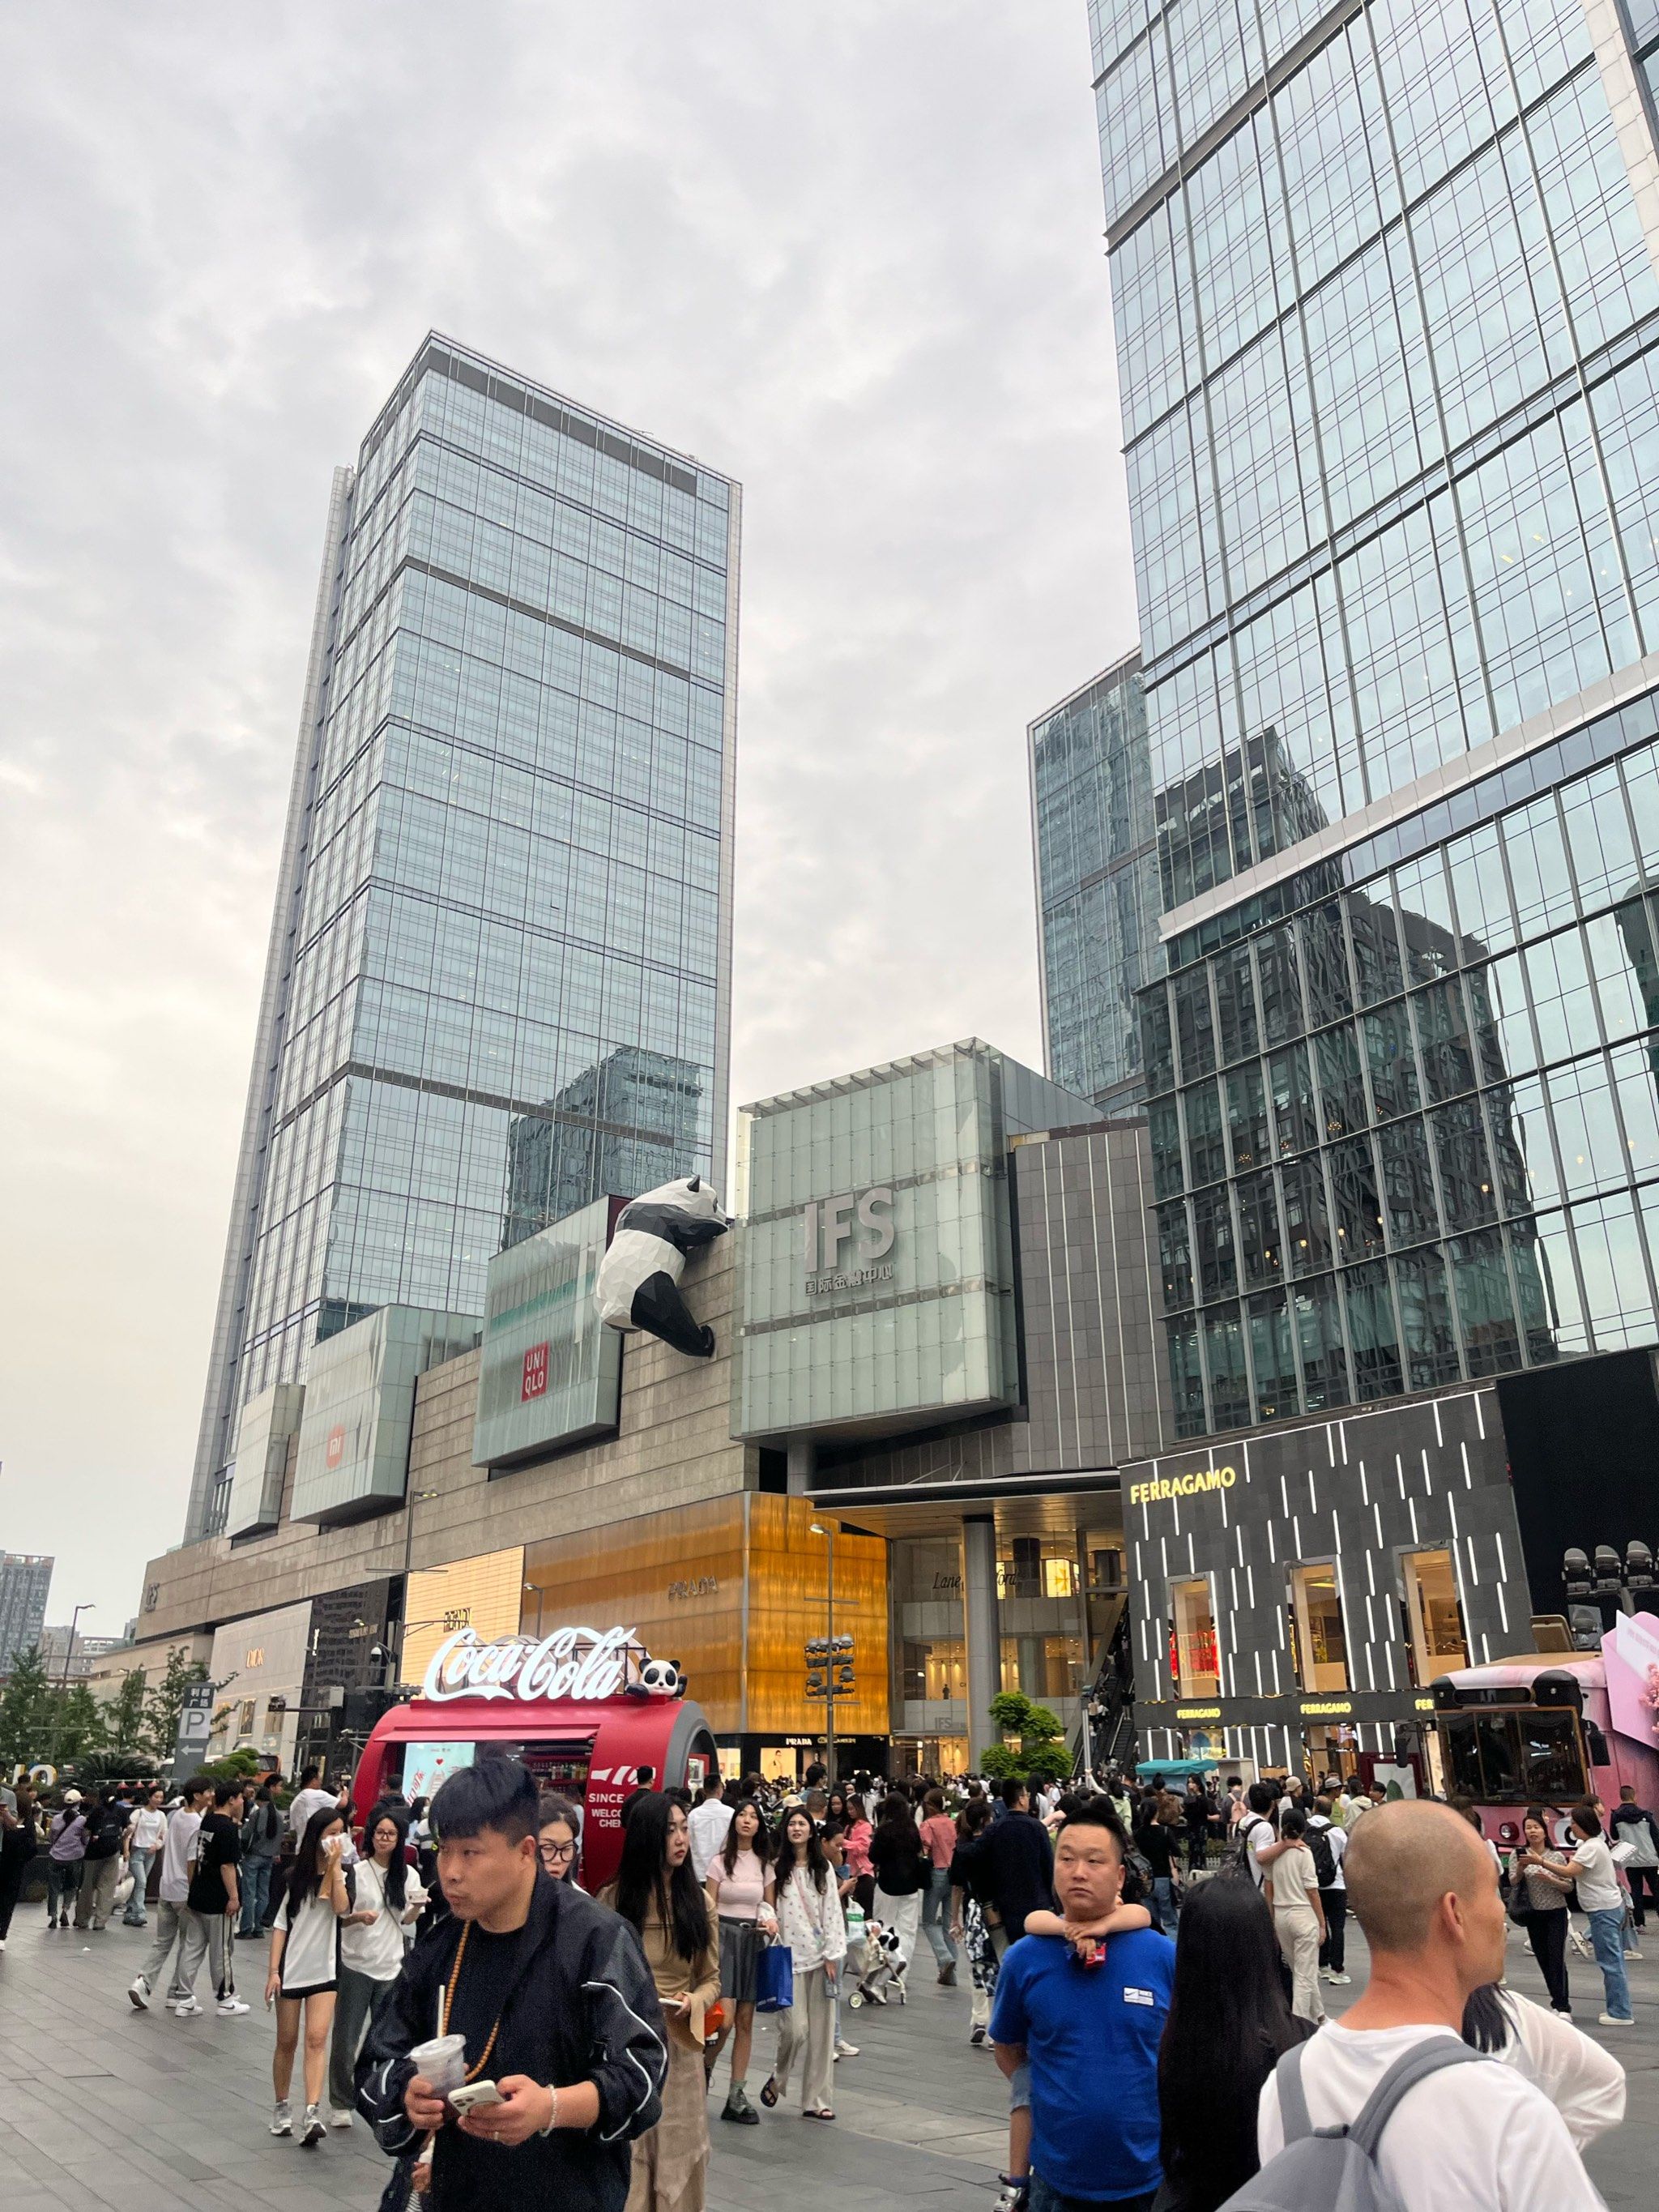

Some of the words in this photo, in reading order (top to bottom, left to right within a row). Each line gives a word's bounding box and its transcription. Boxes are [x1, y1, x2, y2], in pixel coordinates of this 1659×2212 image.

[804, 1187, 894, 1274] IFS
[805, 1262, 893, 1296] 国际金融中心
[527, 1349, 544, 1372] UNI
[525, 1371, 544, 1396] QLO
[1130, 1467, 1236, 1505] FERRAGAMO
[932, 1572, 962, 1589] Lane
[424, 1625, 637, 1702] Coca-Cola
[1176, 1707, 1222, 1719] FERRAGAMO
[1299, 1702, 1352, 1715] FERRAGAMO
[1414, 1698, 1435, 1710] FER
[186, 1711, 206, 1736] P
[785, 1737, 812, 1746] PRADA
[588, 1792, 625, 1804] SINCE
